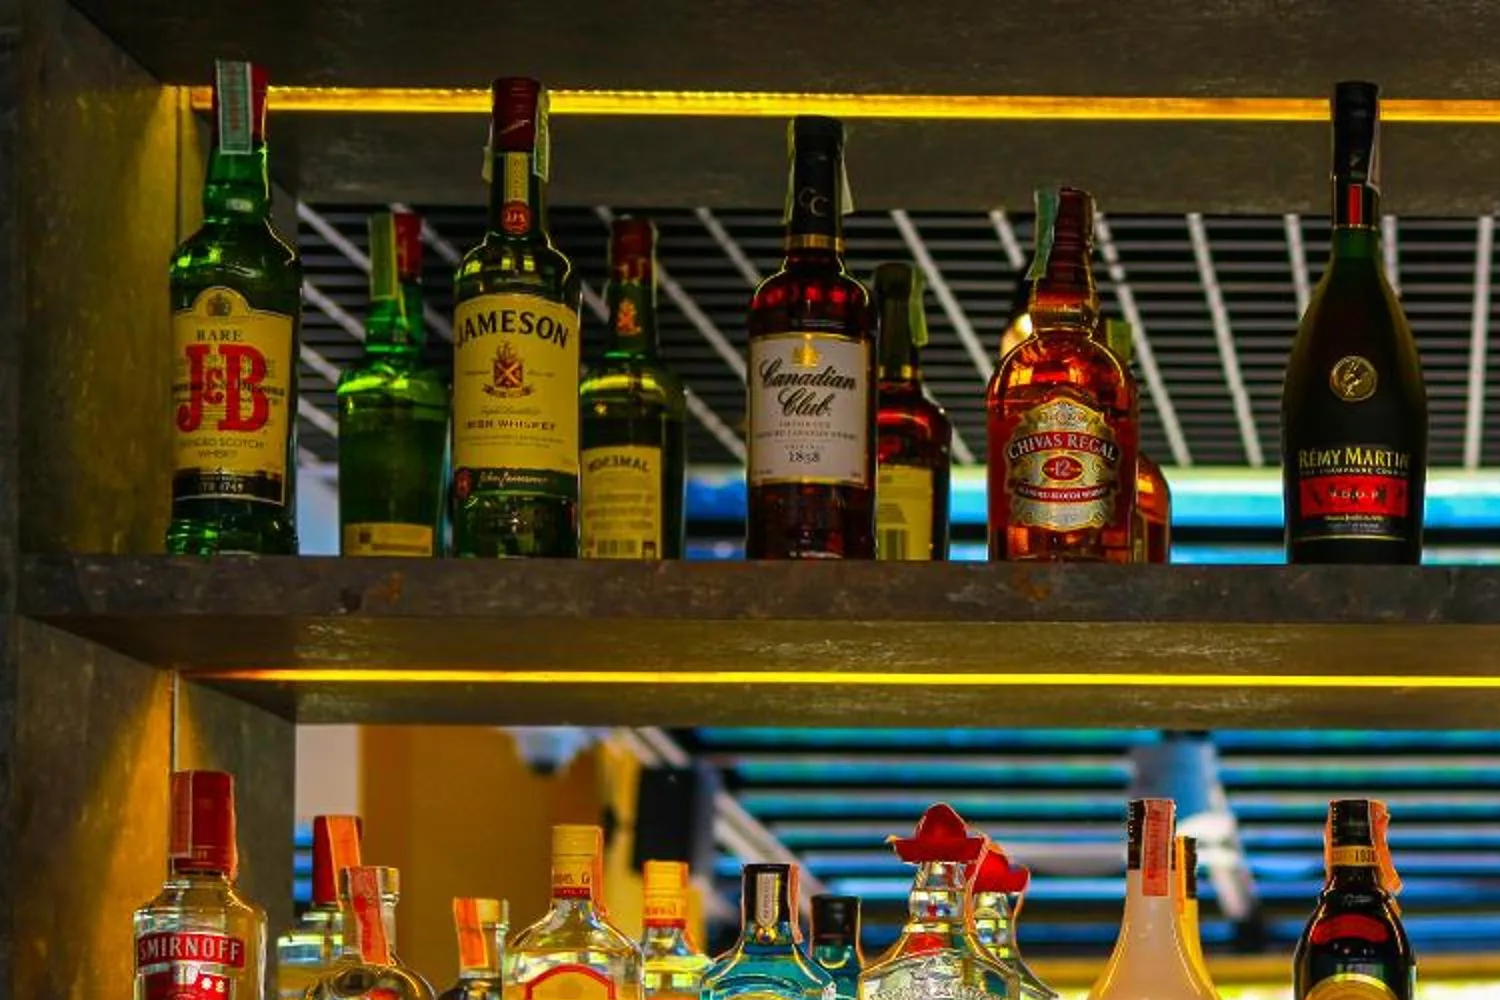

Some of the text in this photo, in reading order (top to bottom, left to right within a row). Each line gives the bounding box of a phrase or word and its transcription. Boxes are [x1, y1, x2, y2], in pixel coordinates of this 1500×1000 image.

[196, 329, 244, 342] RARE
[457, 309, 569, 350] JAMESON
[176, 344, 270, 433] J&B
[758, 357, 857, 391] Canadian
[1008, 433, 1116, 462] CHIVAS REGAL
[1344, 446, 1409, 468] MARTIN
[138, 934, 242, 962] SMIRNOFF
